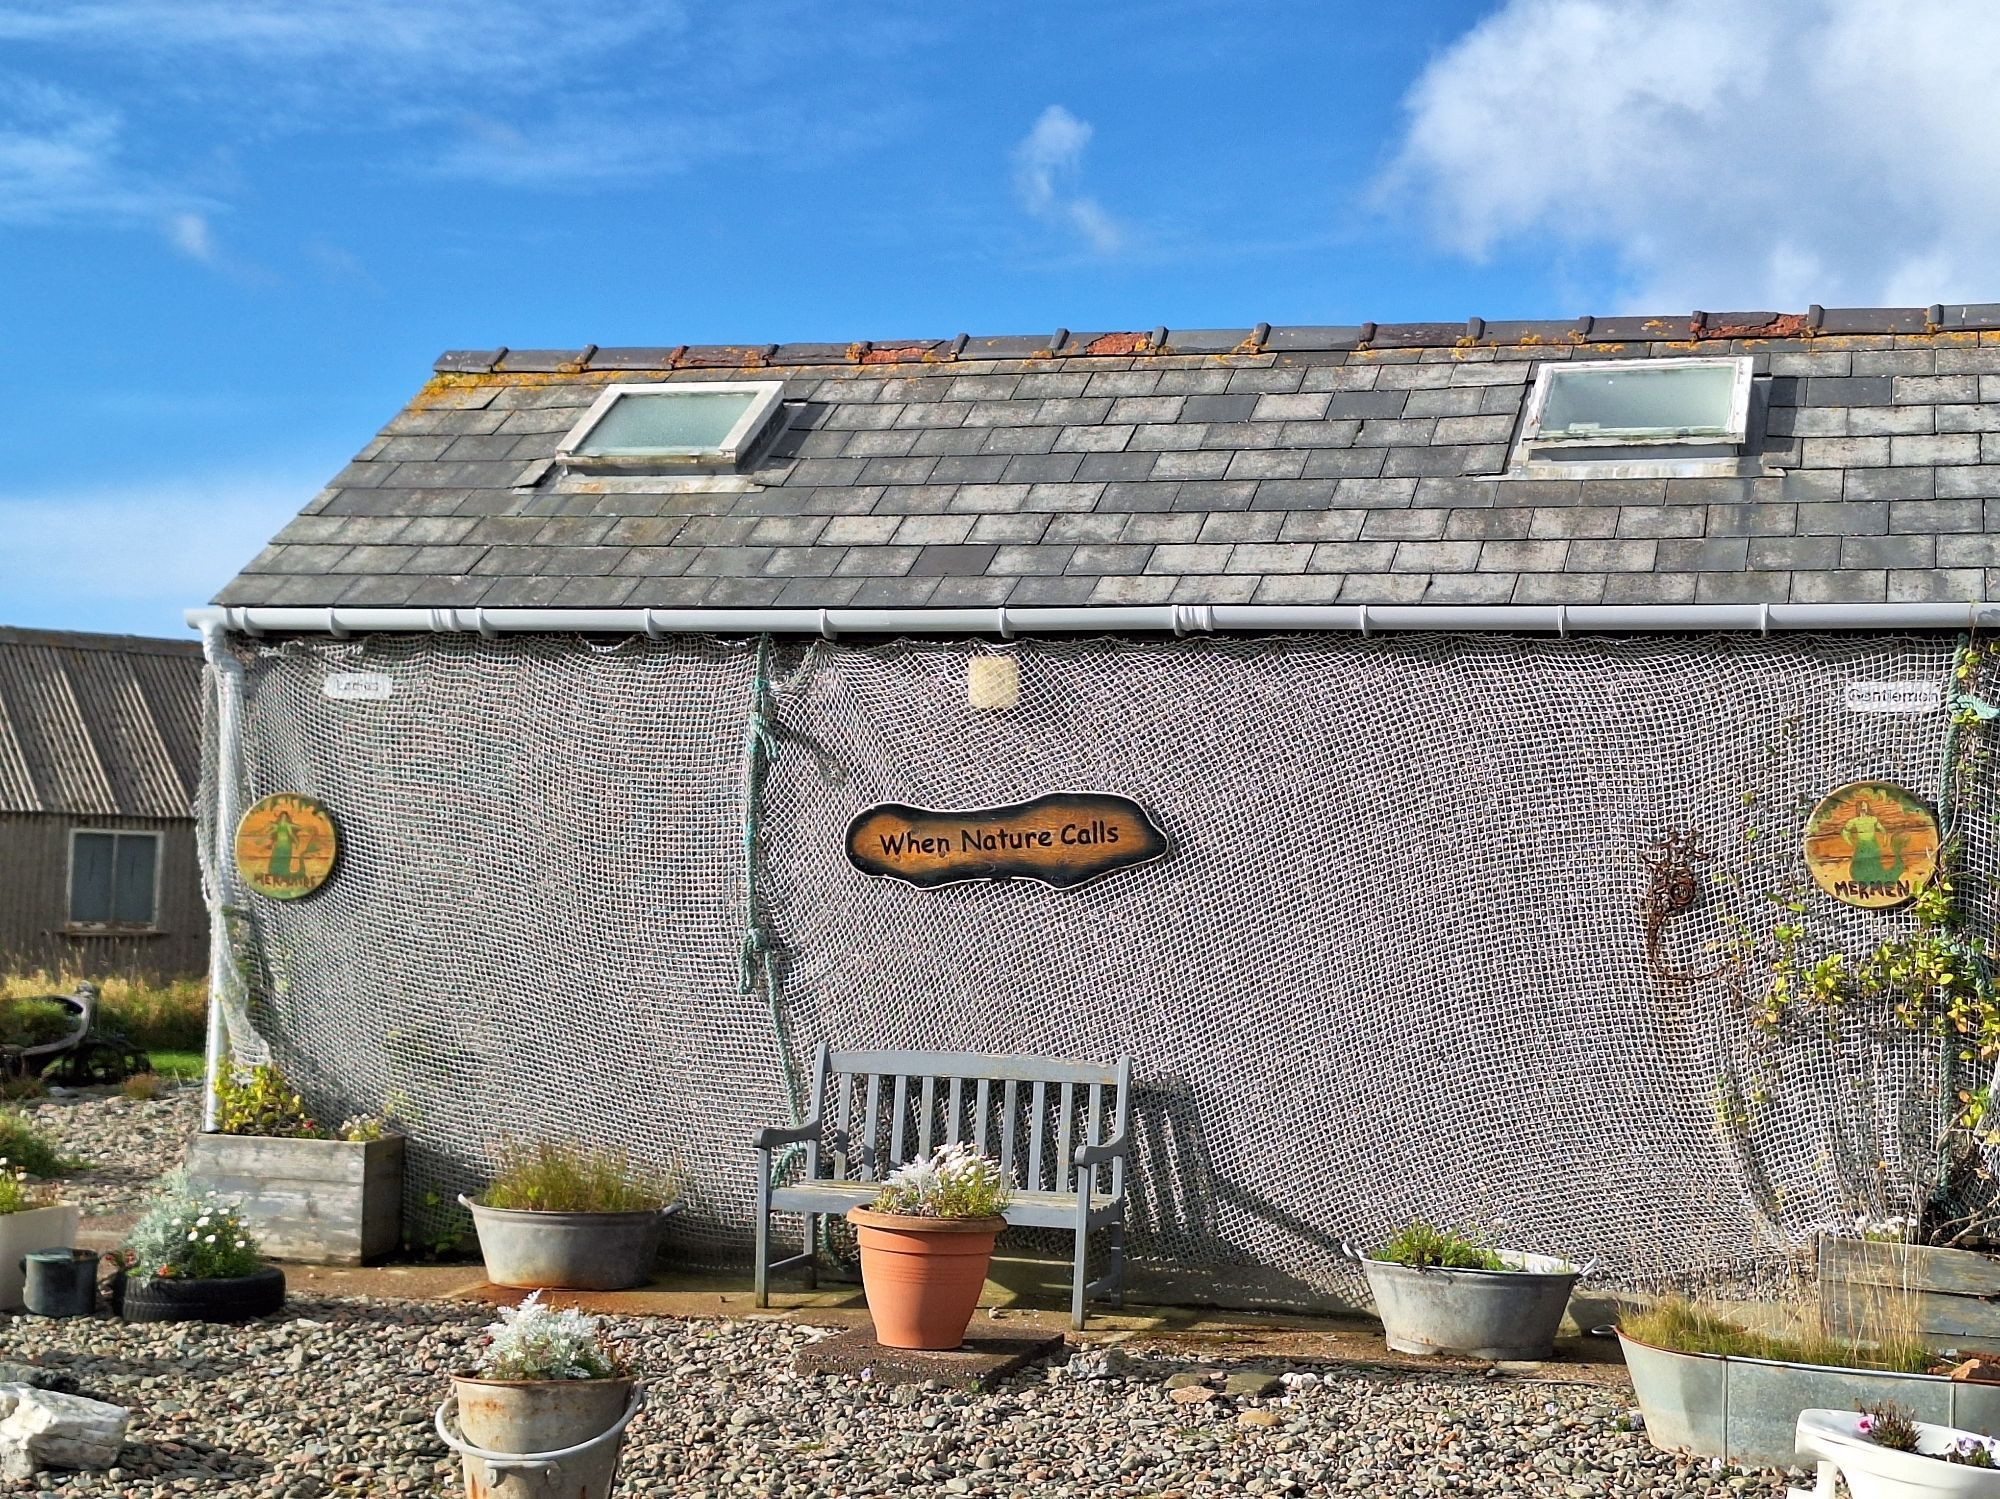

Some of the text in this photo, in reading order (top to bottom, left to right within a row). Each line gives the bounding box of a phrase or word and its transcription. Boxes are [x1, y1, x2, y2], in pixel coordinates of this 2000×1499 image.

[879, 820, 1119, 855] When Nature Calls
[1834, 880, 1910, 900] MERMEN
